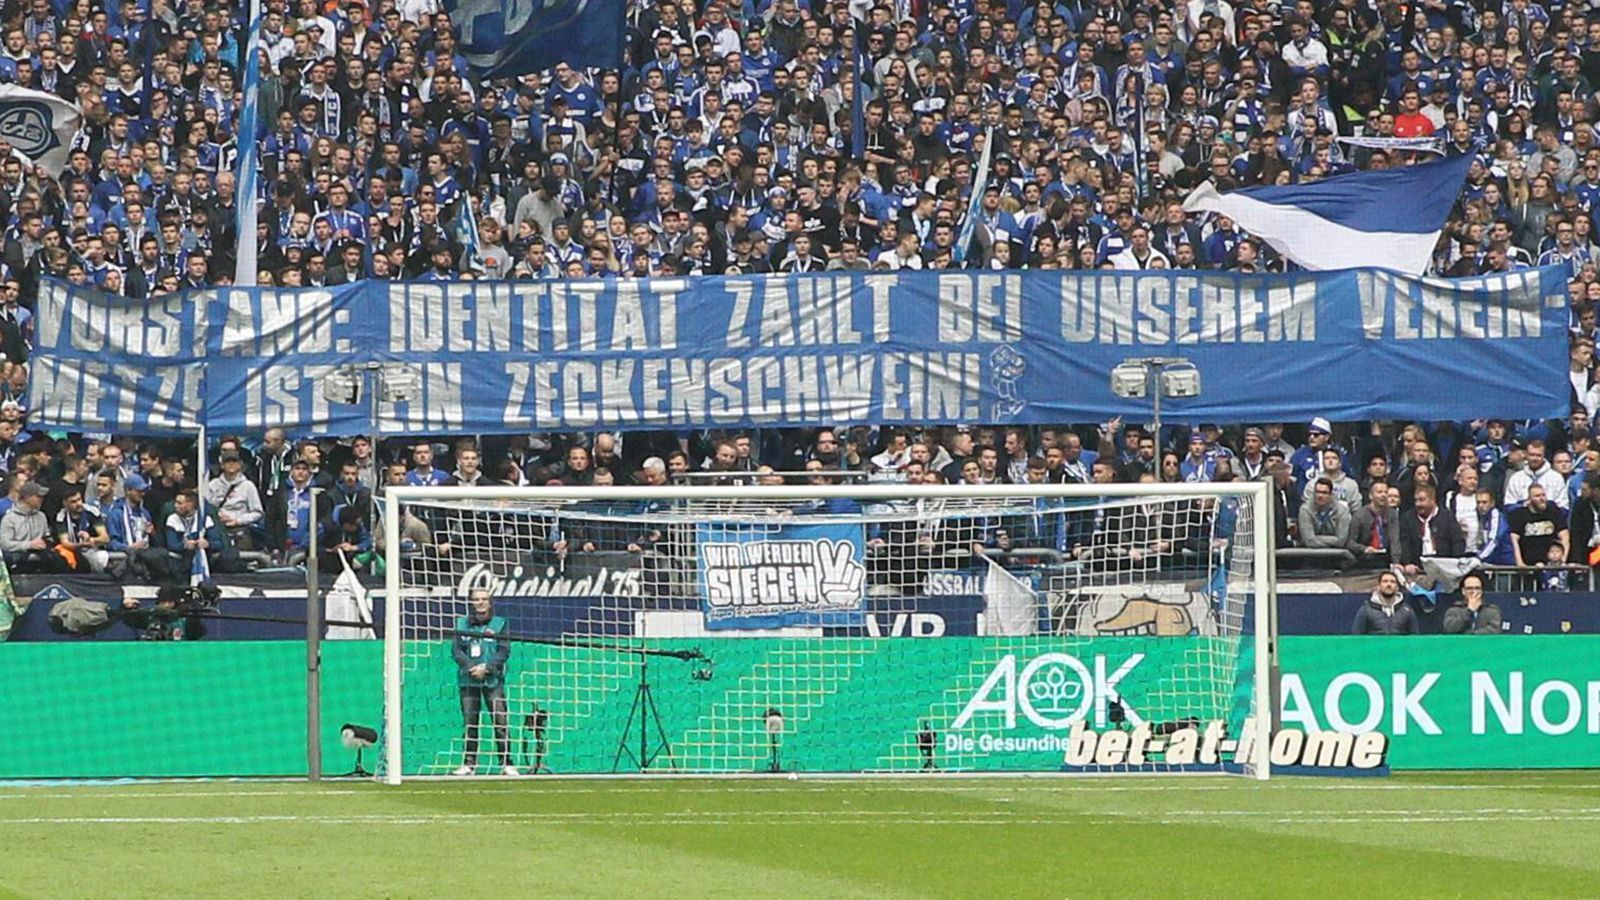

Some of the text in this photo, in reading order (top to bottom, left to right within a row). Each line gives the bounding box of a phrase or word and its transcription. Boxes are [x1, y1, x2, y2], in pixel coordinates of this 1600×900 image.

[37, 270, 1565, 358] VORSTAND: IDENTITÄT ZÄHLT BEI UNSEREM VEREIN-
[246, 364, 336, 433] IST
[503, 351, 980, 425] ZECKENSCHWEIN!
[704, 542, 814, 566] WIR WERDEN
[708, 566, 819, 606] SIEGEN
[951, 653, 1146, 729] AOK
[1279, 672, 1443, 735] AOK
[945, 734, 974, 752] Die
